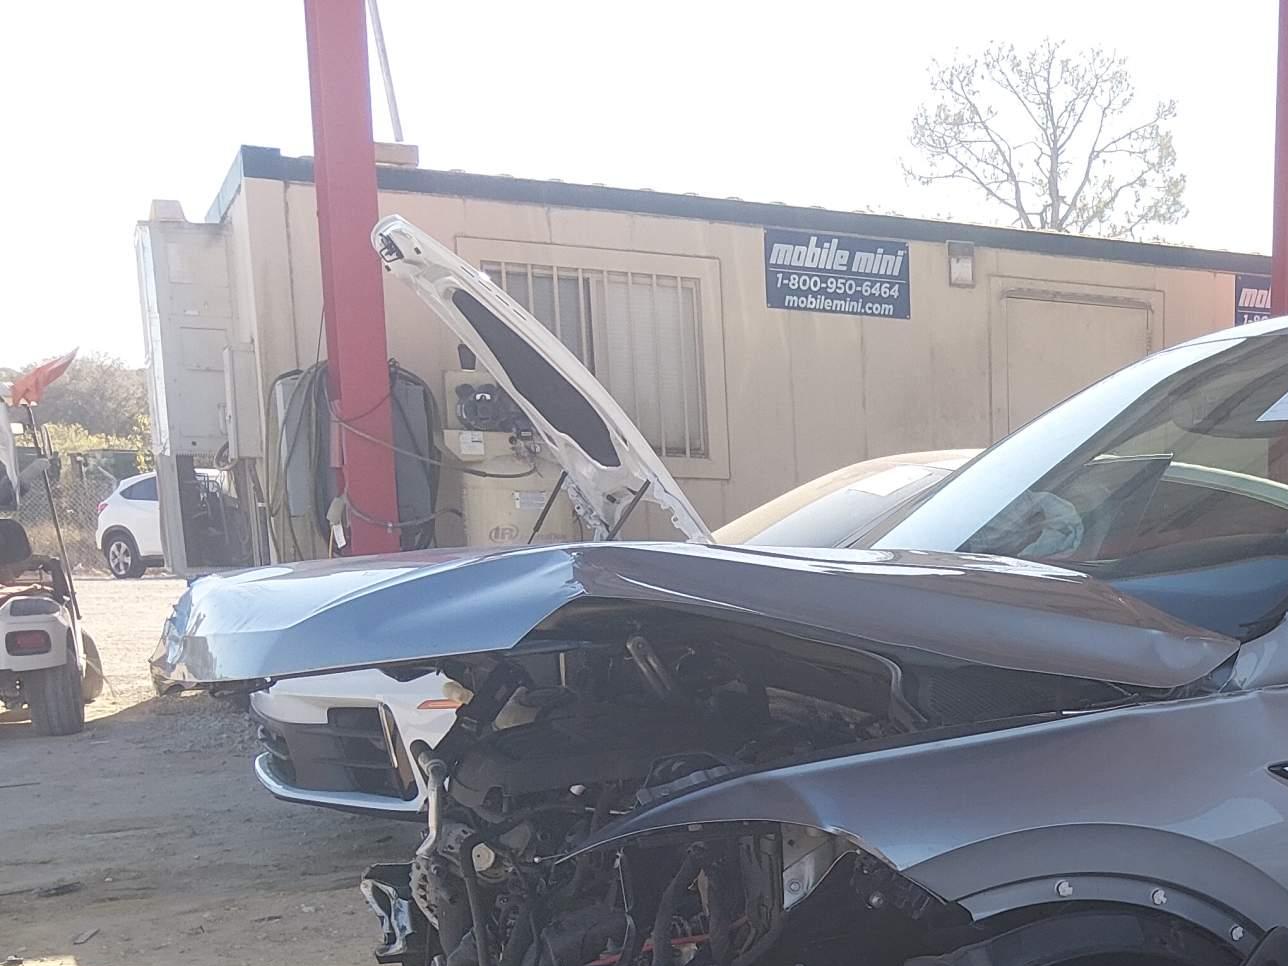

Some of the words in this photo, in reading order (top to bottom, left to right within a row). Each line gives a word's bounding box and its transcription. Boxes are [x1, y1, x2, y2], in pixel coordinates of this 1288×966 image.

[769, 236, 849, 271] mobile
[851, 248, 905, 276] mini
[776, 273, 899, 299] 1-800-950-6464
[785, 294, 894, 316] mobilemini.com
